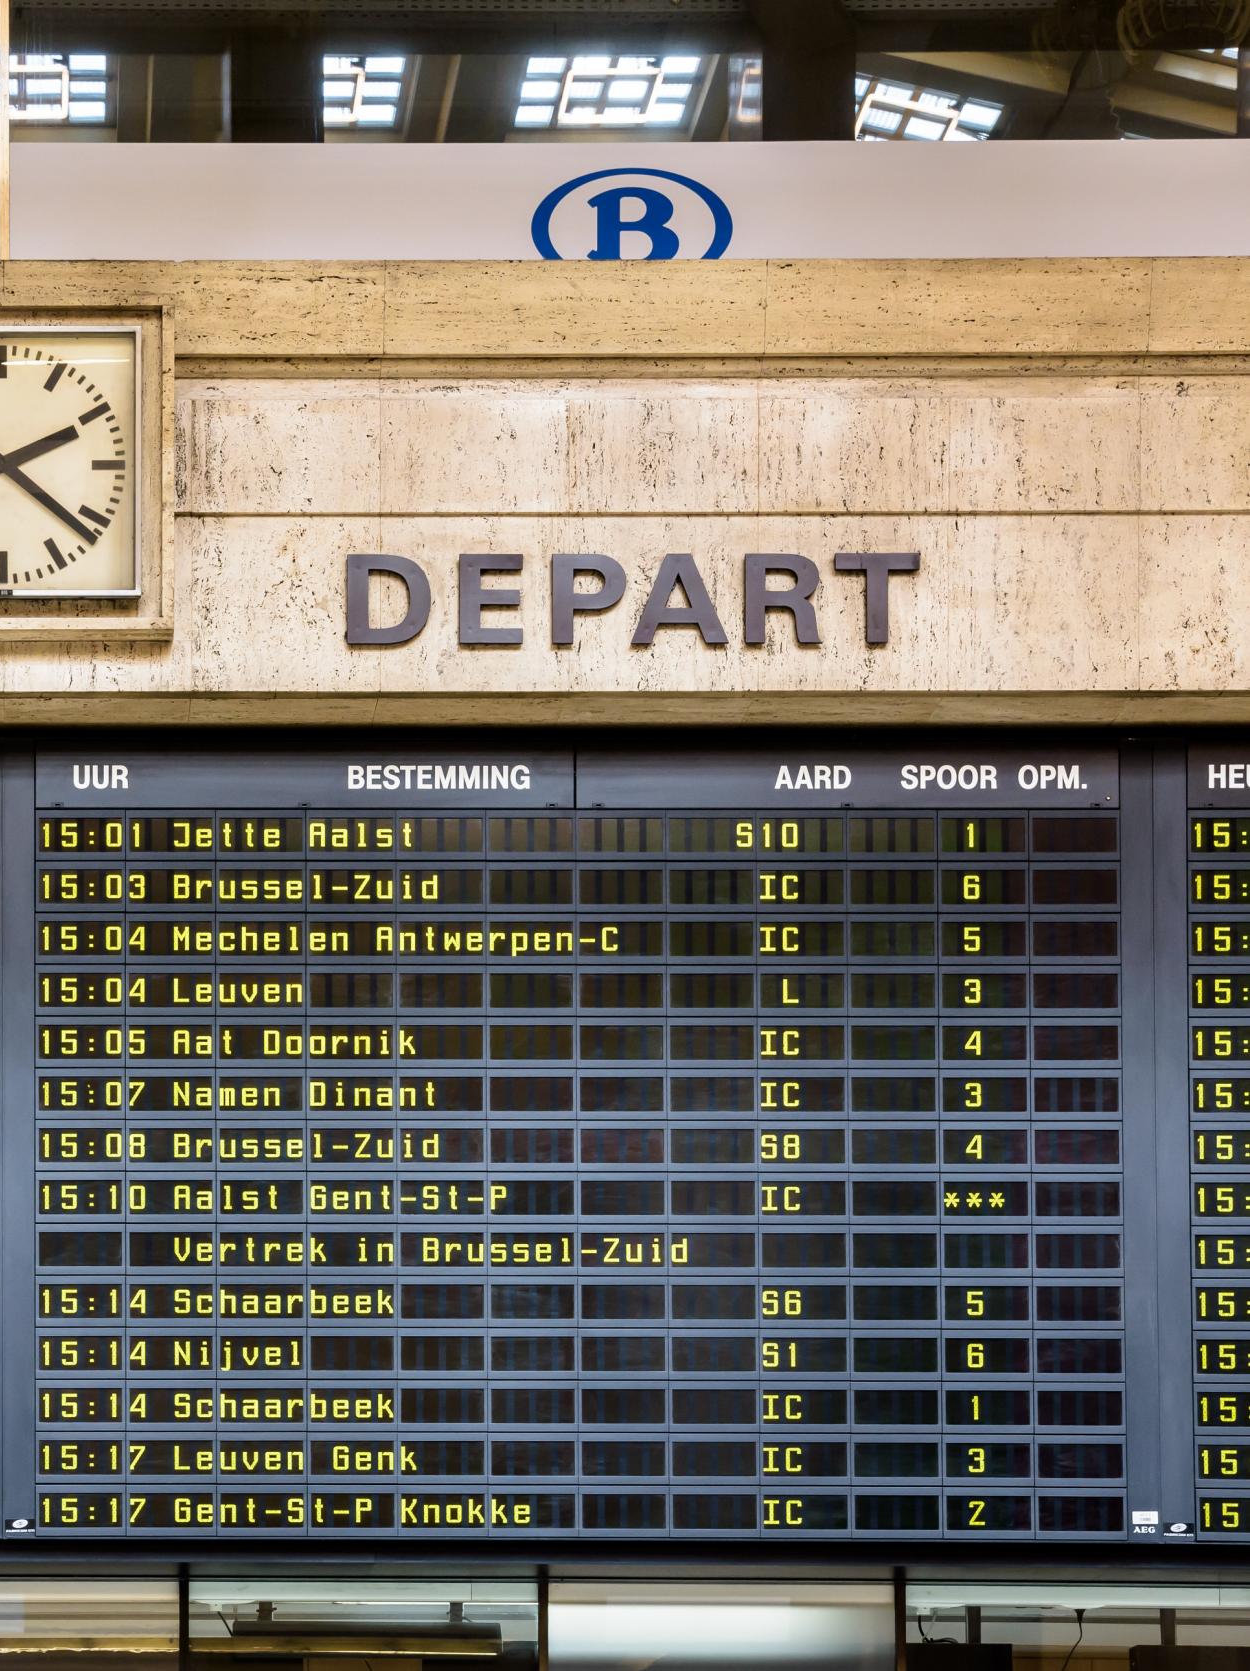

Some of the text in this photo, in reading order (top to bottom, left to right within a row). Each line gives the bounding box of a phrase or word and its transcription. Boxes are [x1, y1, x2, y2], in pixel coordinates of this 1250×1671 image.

[345, 552, 921, 646] DEPART
[72, 764, 1088, 791] UUR BESTEMMING AARD SPOOR OPM.
[42, 822, 975, 848] 15:01 Jette Aalst S10 1
[42, 873, 981, 900] 15:03 Brussel-Zuid IC 6
[42, 925, 981, 957] 15:04 Mechelen Antwerpen-C IC 5
[42, 977, 982, 1004] 15:04 Leuven L 3
[42, 1029, 982, 1056] 15:05 Aat Doornik IC 4
[42, 1081, 982, 1108] 15:07 Namen Dinant IC 3
[42, 1132, 983, 1160] 15:08 Brussel-Zuid S8 4
[42, 1184, 800, 1212] 15:10 Aalst Gent-St-P IC
[173, 1236, 688, 1264] Vertrek in Brussel-Zuid
[42, 1288, 984, 1316] 15:14 Schaarbeek S6 5
[42, 1340, 984, 1371] 15:14 Nijvel S1 6
[42, 1392, 979, 1421] 15:14 Schaarbeek IC 1
[42, 1444, 985, 1473] 15:17 Leuven Genk IC 3
[42, 1497, 986, 1526] 15:17 Gent-St-P Knokke IC 2
[1133, 1526, 1156, 1534] AEG
